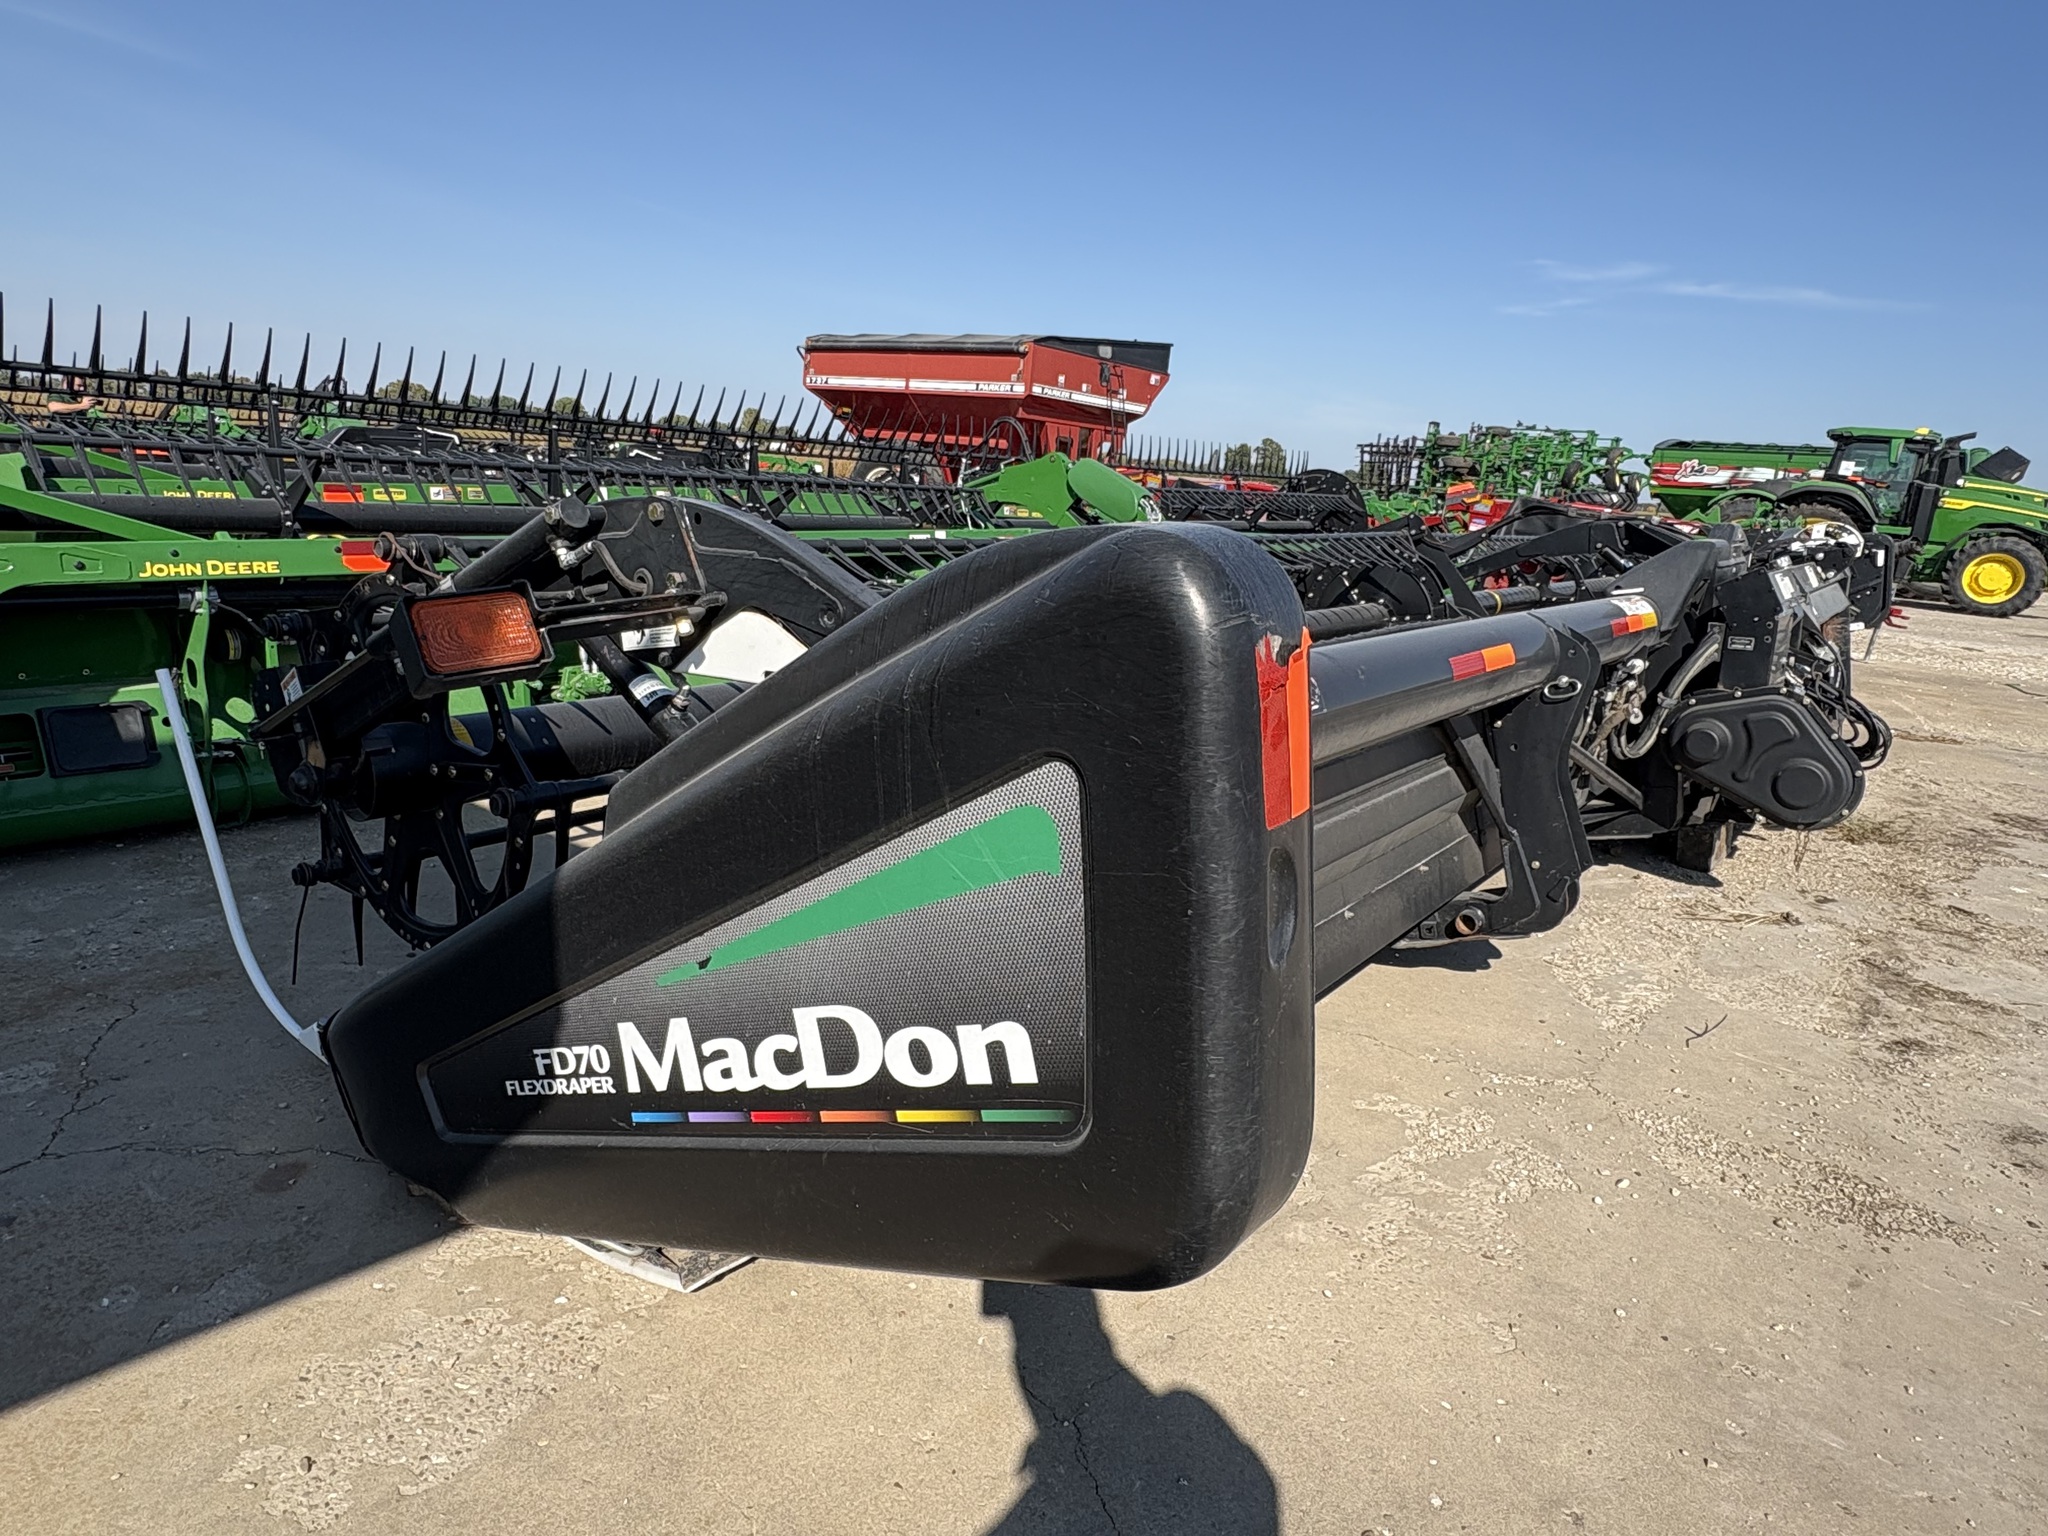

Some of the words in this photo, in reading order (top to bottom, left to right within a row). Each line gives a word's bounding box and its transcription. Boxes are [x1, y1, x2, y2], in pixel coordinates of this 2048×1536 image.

[978, 383, 1012, 392] PARKER
[1042, 387, 1071, 399] PARKER
[139, 560, 203, 578] JOHN
[205, 559, 281, 576] DEERE
[617, 1004, 1039, 1094] MacDon
[533, 1043, 612, 1077] FD70
[505, 1075, 615, 1097] FLEXDRAPER
